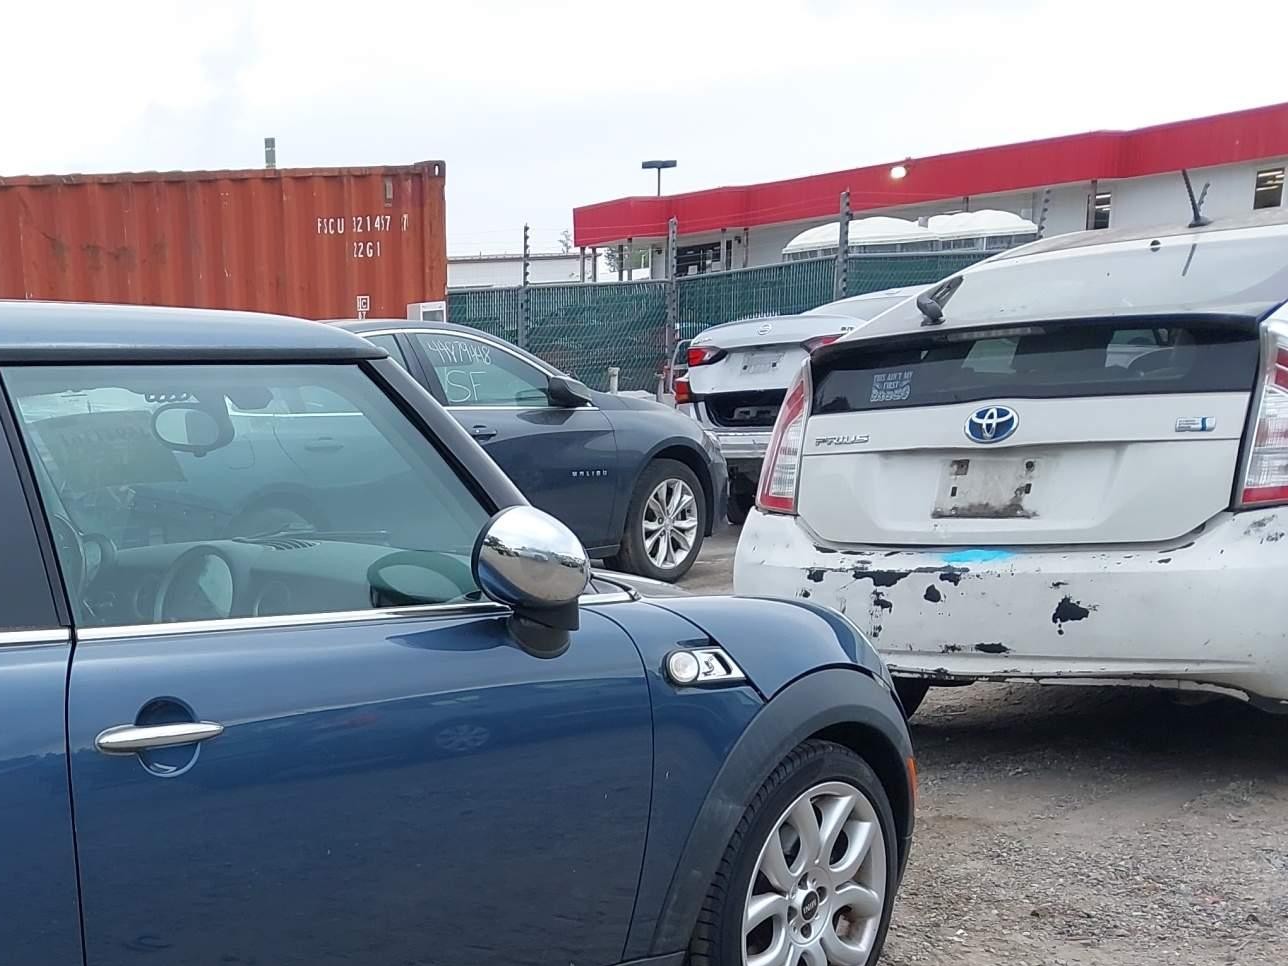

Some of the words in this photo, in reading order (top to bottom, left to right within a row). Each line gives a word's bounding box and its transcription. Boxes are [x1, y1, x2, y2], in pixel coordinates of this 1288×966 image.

[317, 217, 345, 234] FSCU
[353, 241, 381, 258] 22G1
[815, 435, 870, 447] PRIUS
